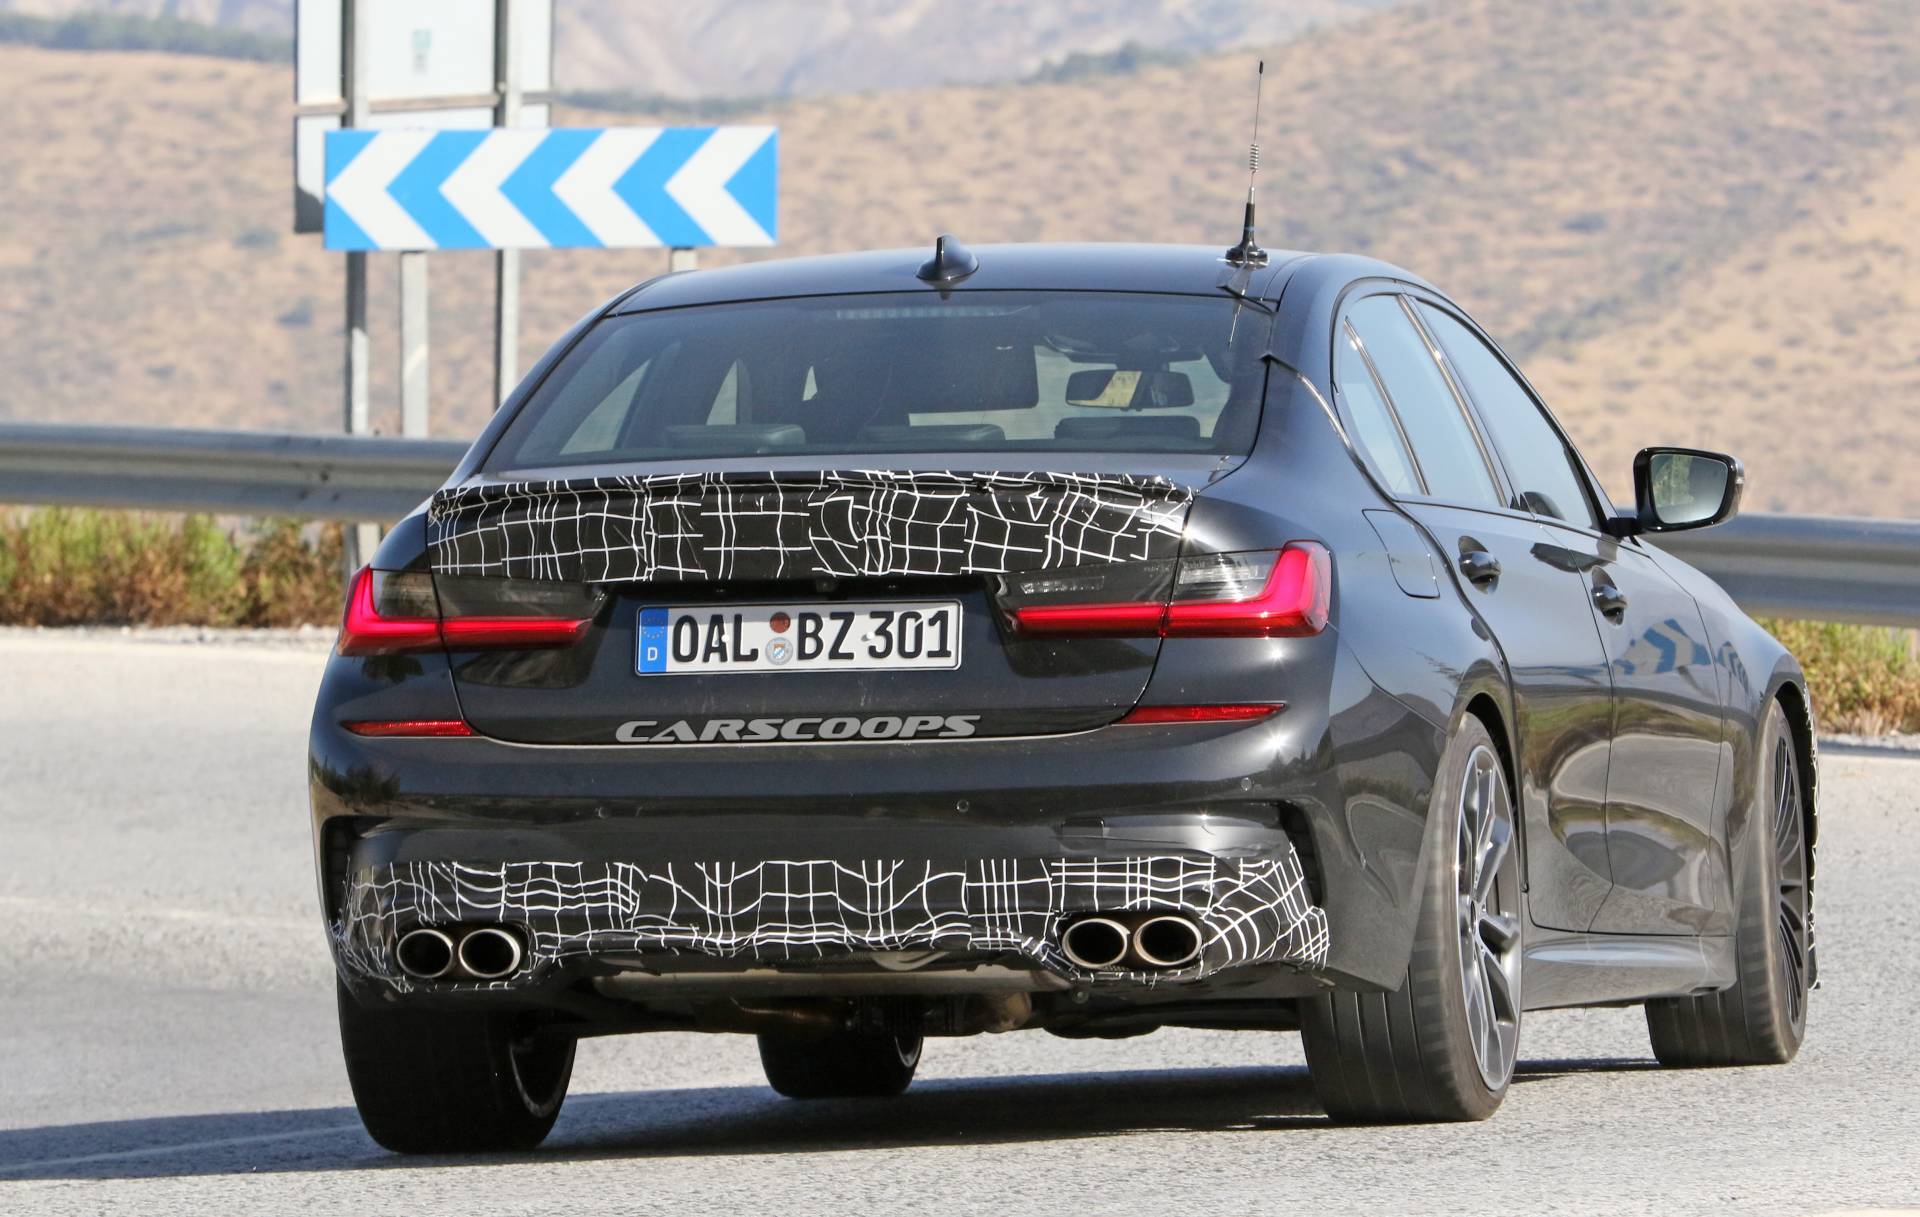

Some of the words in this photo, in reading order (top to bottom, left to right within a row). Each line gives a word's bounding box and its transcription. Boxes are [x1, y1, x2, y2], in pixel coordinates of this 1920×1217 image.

[672, 614, 759, 663] OAL
[798, 611, 855, 660] BZ
[868, 610, 952, 659] 301
[647, 647, 658, 661] D
